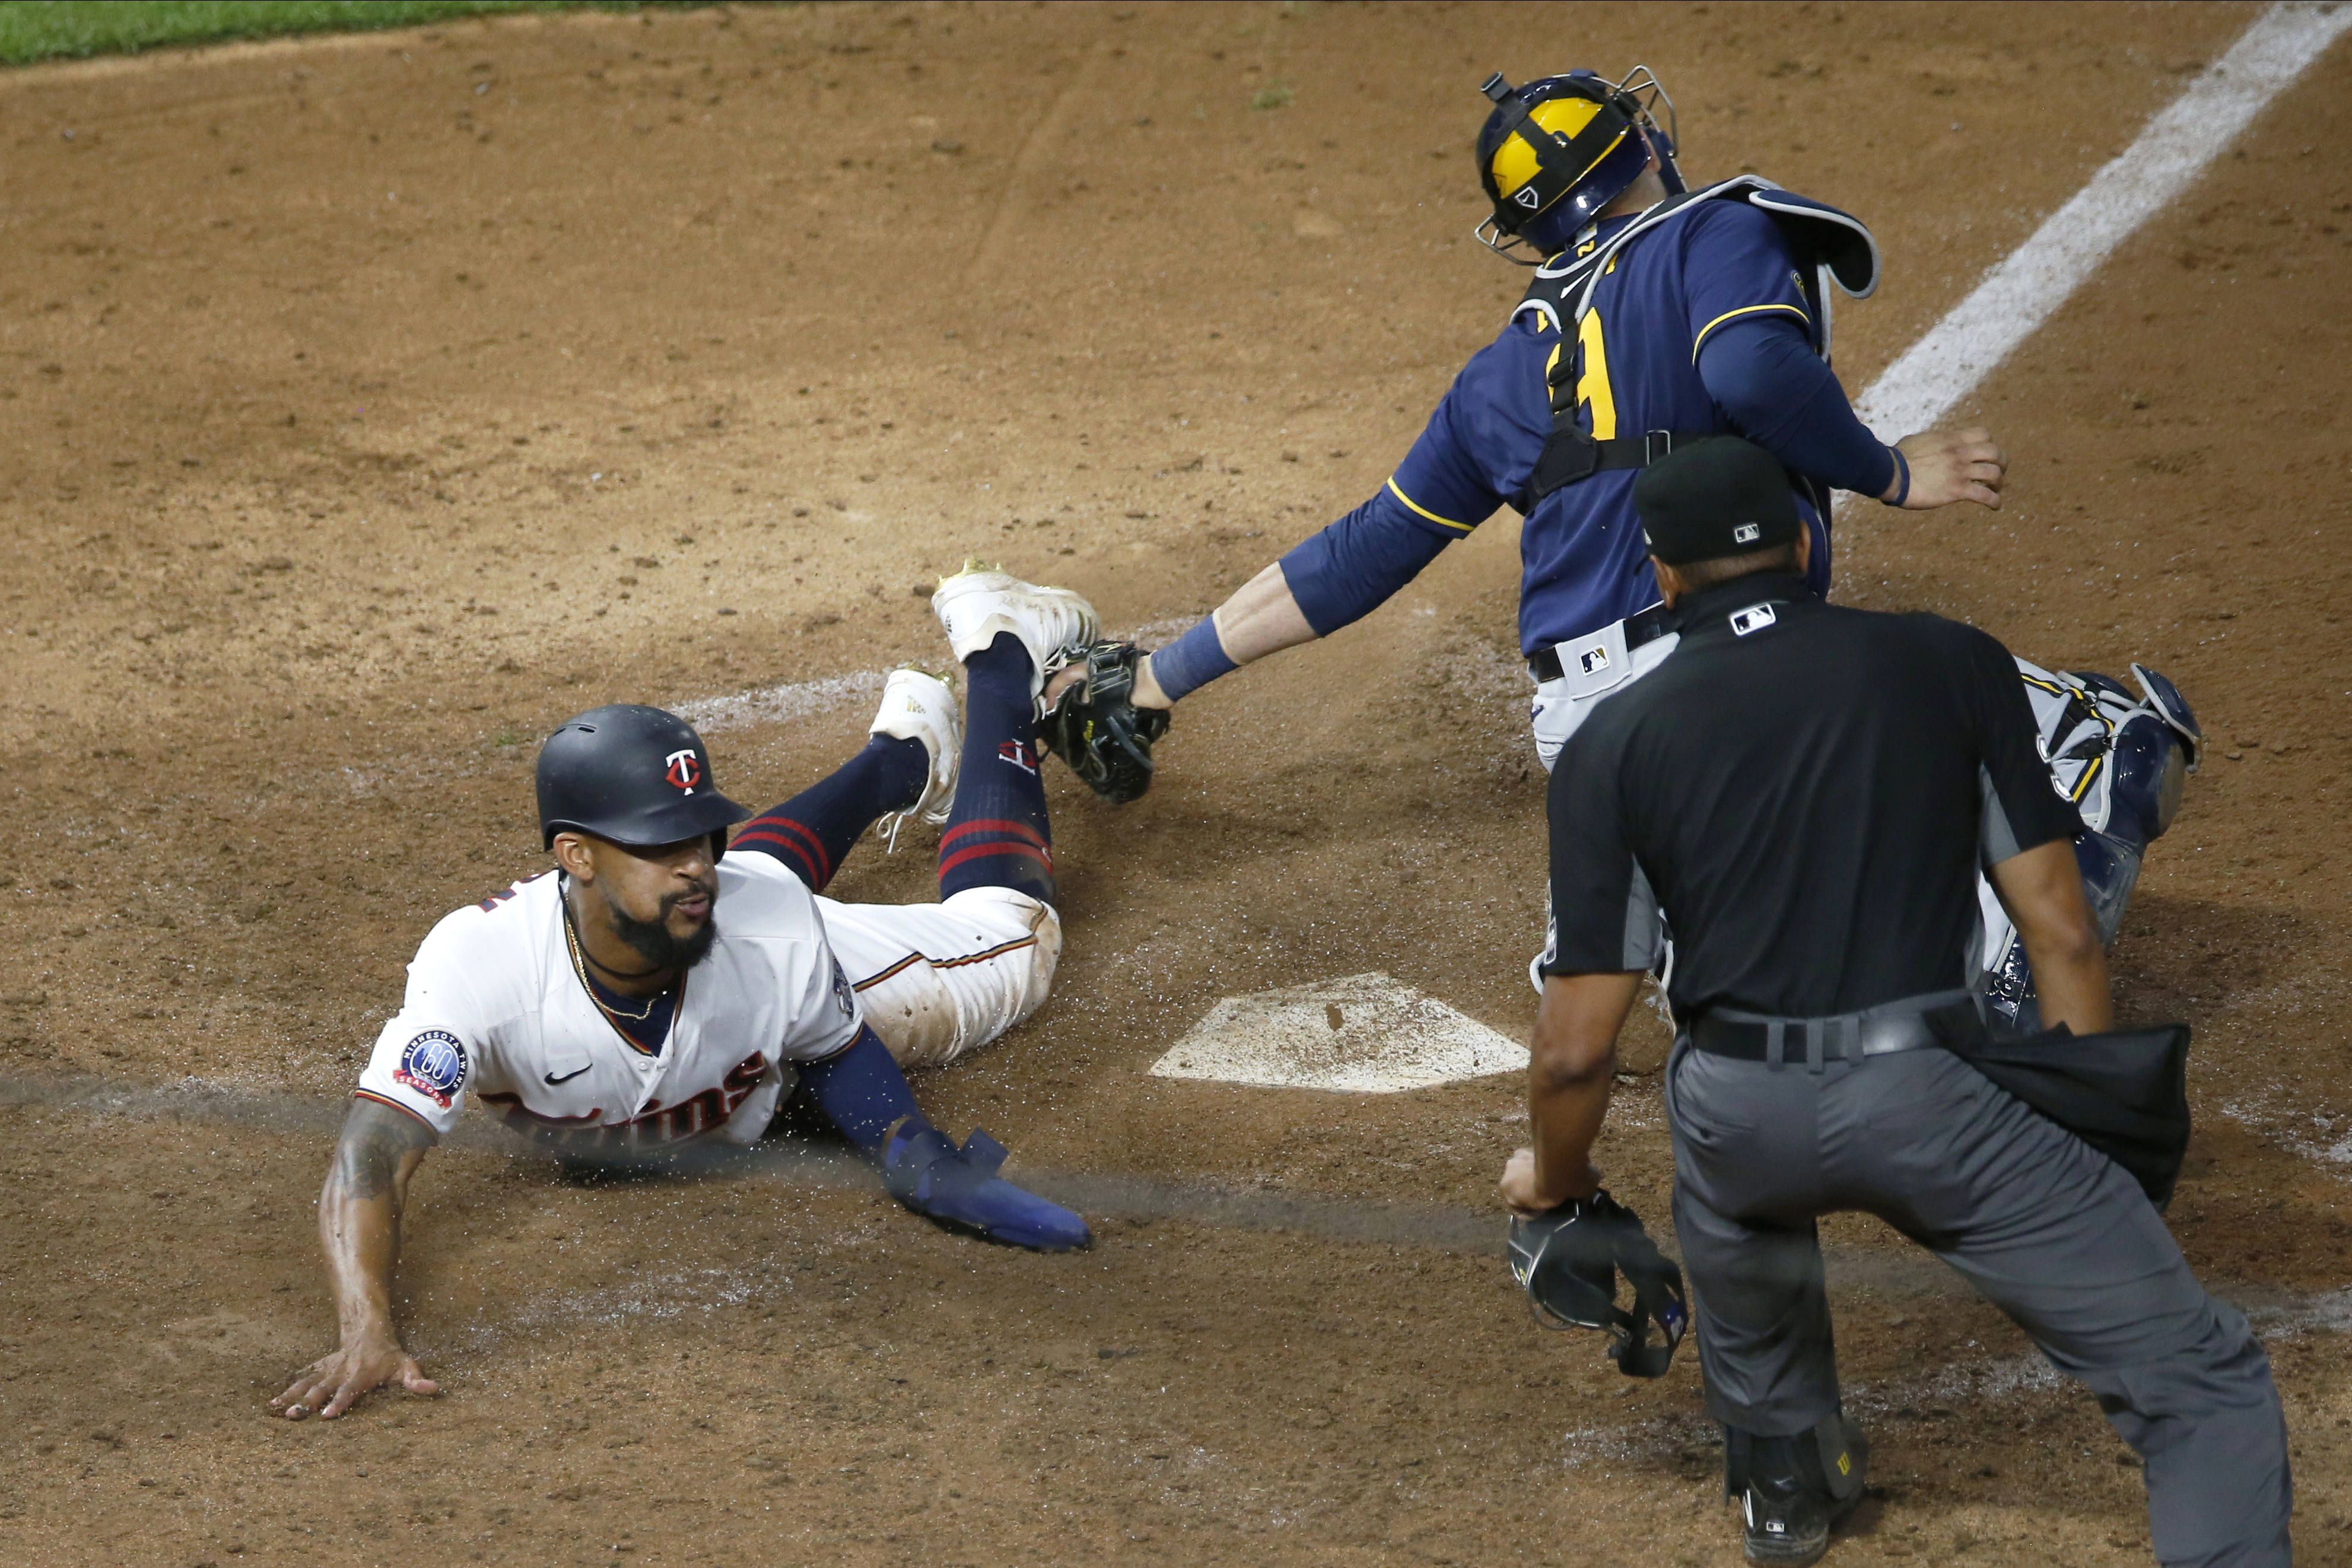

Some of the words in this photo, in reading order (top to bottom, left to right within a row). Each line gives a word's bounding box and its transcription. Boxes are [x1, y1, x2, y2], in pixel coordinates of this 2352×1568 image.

[403, 1032, 459, 1059] MINNESOTA
[453, 1054, 467, 1089] TWINS
[421, 1043, 453, 1080] 60
[399, 1076, 444, 1105] SEASONS
